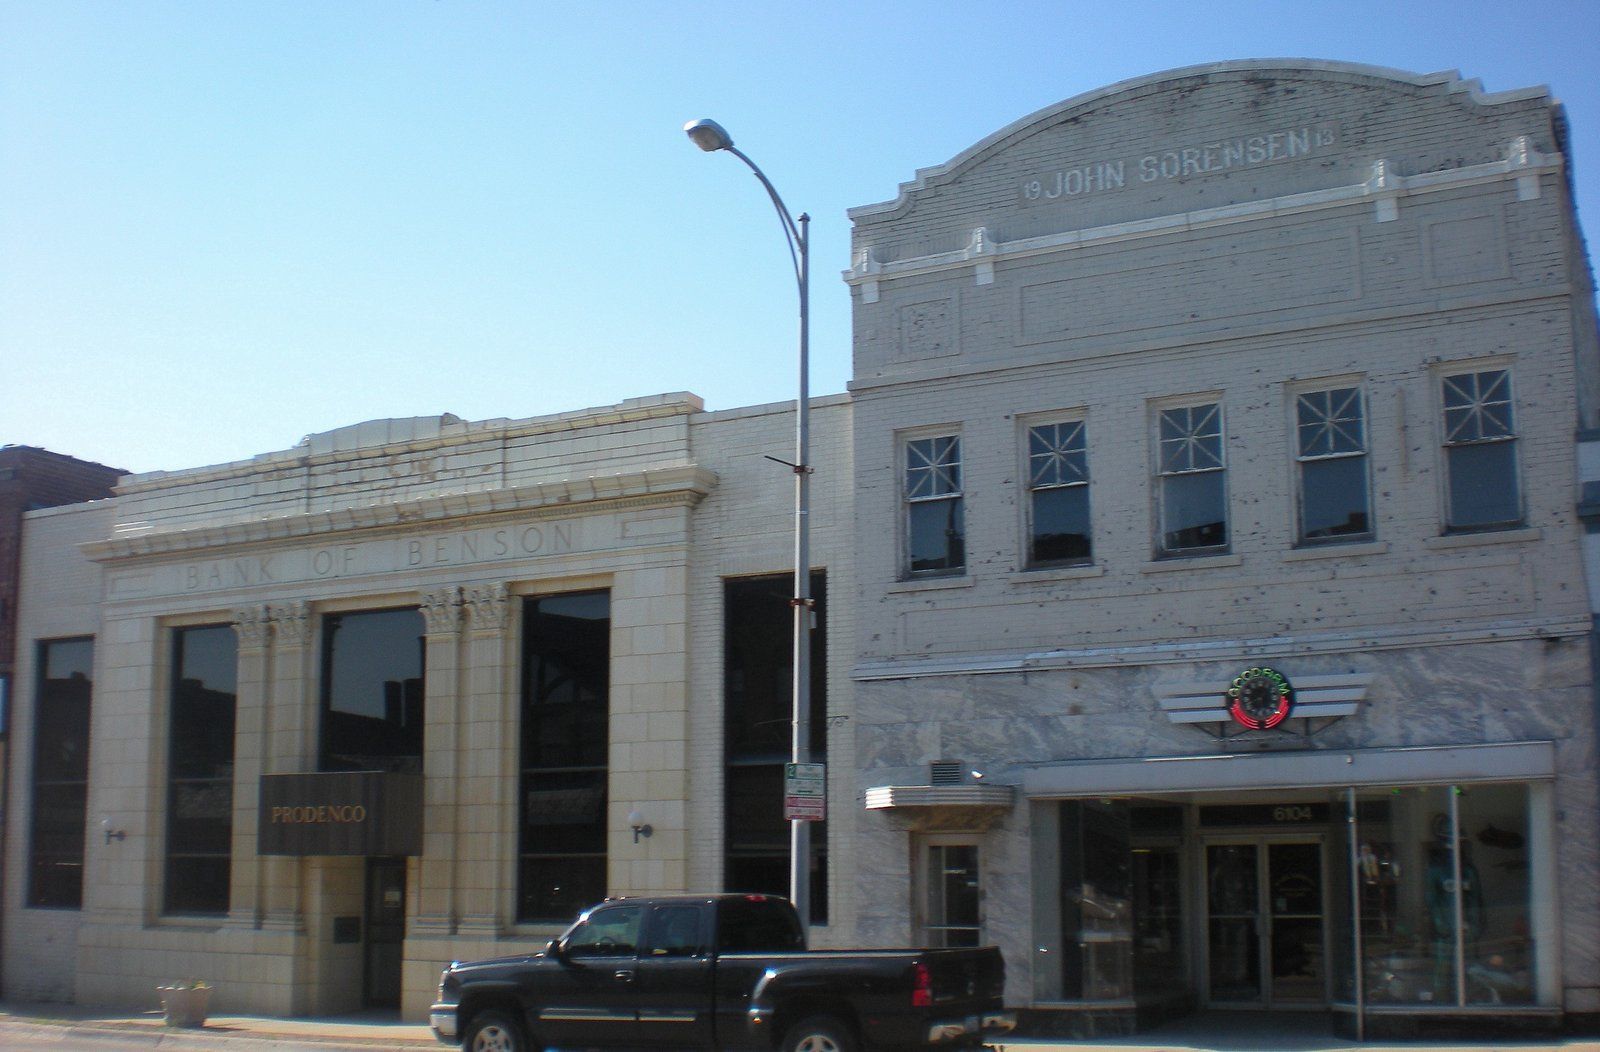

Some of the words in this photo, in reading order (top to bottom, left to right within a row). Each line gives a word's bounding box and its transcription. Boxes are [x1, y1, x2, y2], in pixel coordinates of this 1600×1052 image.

[1023, 181, 1042, 200] 19
[1045, 160, 1126, 200] JOHN
[1139, 127, 1311, 183] SORENSEN
[186, 558, 273, 590] BANK
[312, 547, 357, 576] OF
[407, 522, 575, 567] BENSON
[271, 805, 366, 823] PRODENCO
[1274, 806, 1312, 821] 6104
